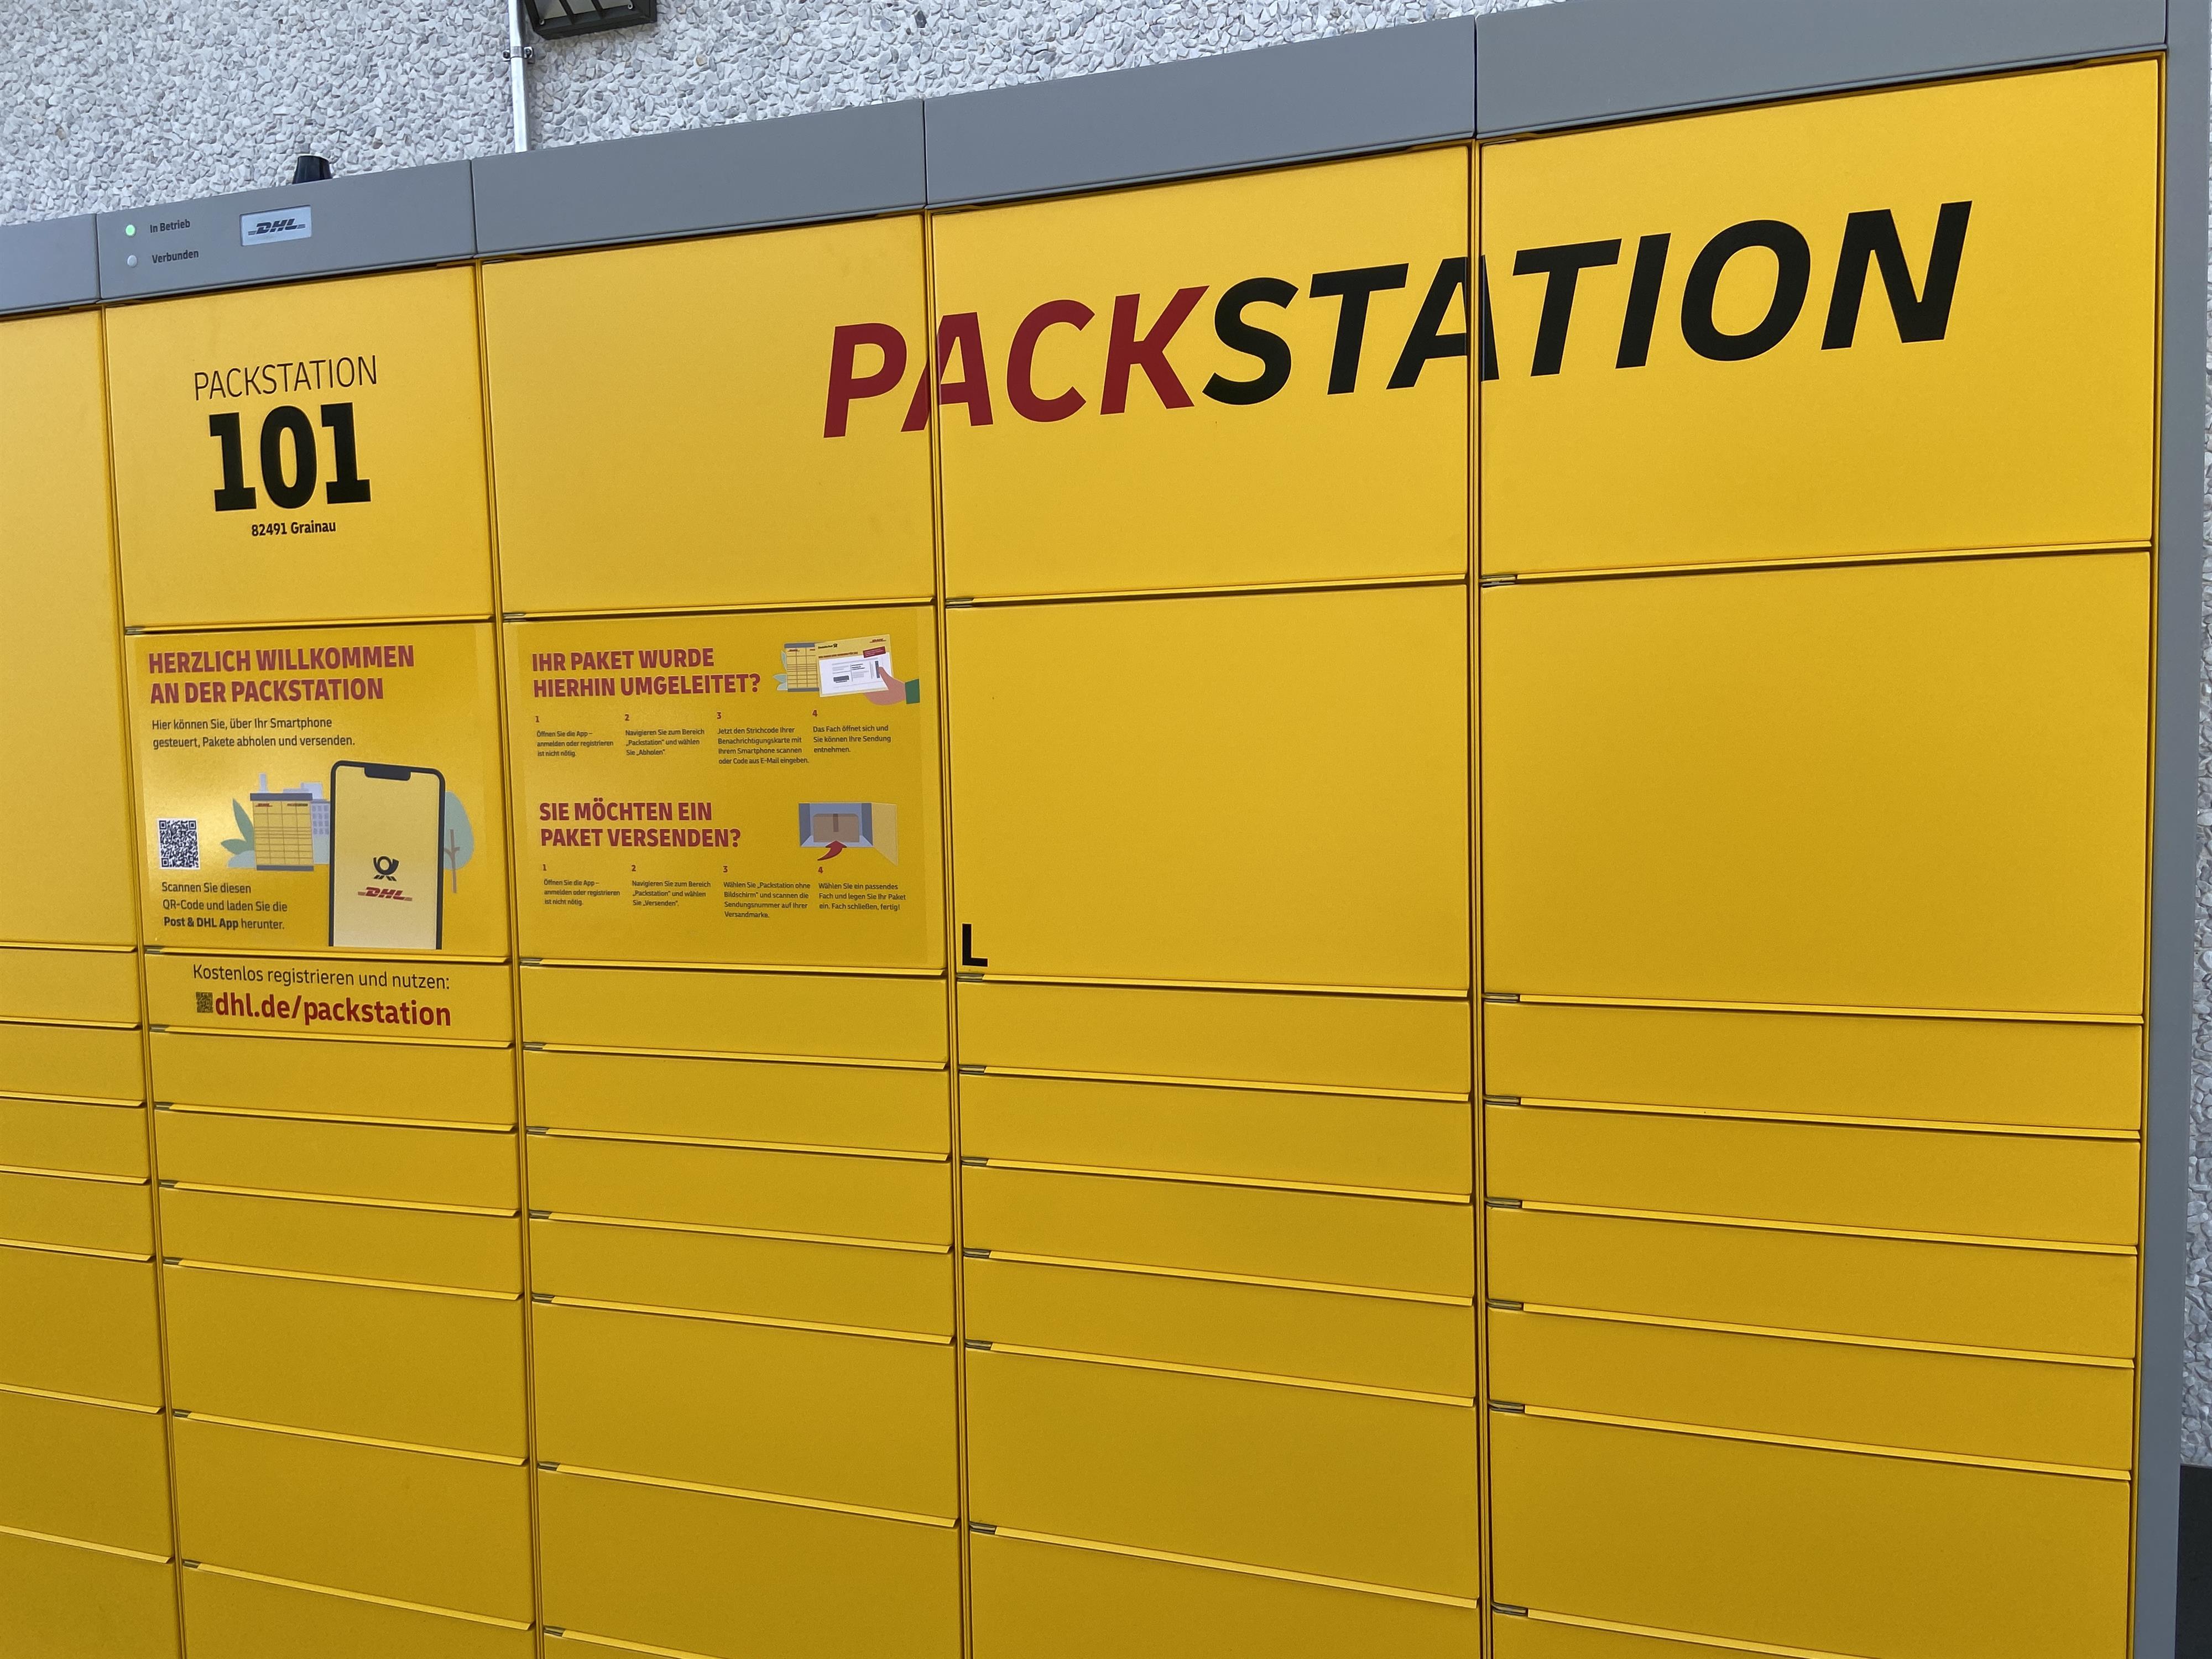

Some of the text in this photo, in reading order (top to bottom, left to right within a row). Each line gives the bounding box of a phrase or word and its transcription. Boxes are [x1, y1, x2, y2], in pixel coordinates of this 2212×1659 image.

[150, 219, 190, 233] In Betrieb
[254, 218, 298, 234] DHL
[152, 250, 199, 263] Verbunden
[822, 201, 1973, 438] PACKSTATION
[195, 355, 376, 400] PACKSTATION
[209, 403, 371, 512] 101
[252, 520, 336, 536] 82491 Grainau
[149, 645, 414, 674] HERZLICH WILLKOMMEN
[533, 648, 714, 671] IHR PAKET WURDE
[151, 678, 383, 703] AN DER PACKSTATION
[534, 674, 760, 697] HIERHIN UMGELEITET?
[153, 717, 332, 730] Hier können Sie, über Ihr Smartphone
[624, 713, 630, 722] 2
[153, 735, 355, 750] gesteuert, Pakete abholen und versenden.
[581, 740, 613, 748] registrieren
[718, 737, 790, 745] Benachrichtigungskarte
[863, 735, 891, 743] Sendung
[737, 747, 775, 755] Smartphone
[540, 797, 712, 821] SIE MÖCHTEN EIN
[541, 828, 740, 847] PAKET VERSENDEN?
[162, 882, 251, 893] Scannen Sie diesen
[632, 880, 663, 888] Navigieren
[364, 887, 407, 901] DHL
[848, 893, 865, 901] legen
[163, 899, 287, 911] QR-Code und laden Sie die
[724, 901, 780, 910] Sendungsnummer
[164, 917, 284, 930] Post & DHL App herunter.
[962, 924, 988, 967] L
[194, 964, 449, 989] Kostenlos registrieren und nutzen:
[216, 992, 450, 1026] dhl.de/packstation
